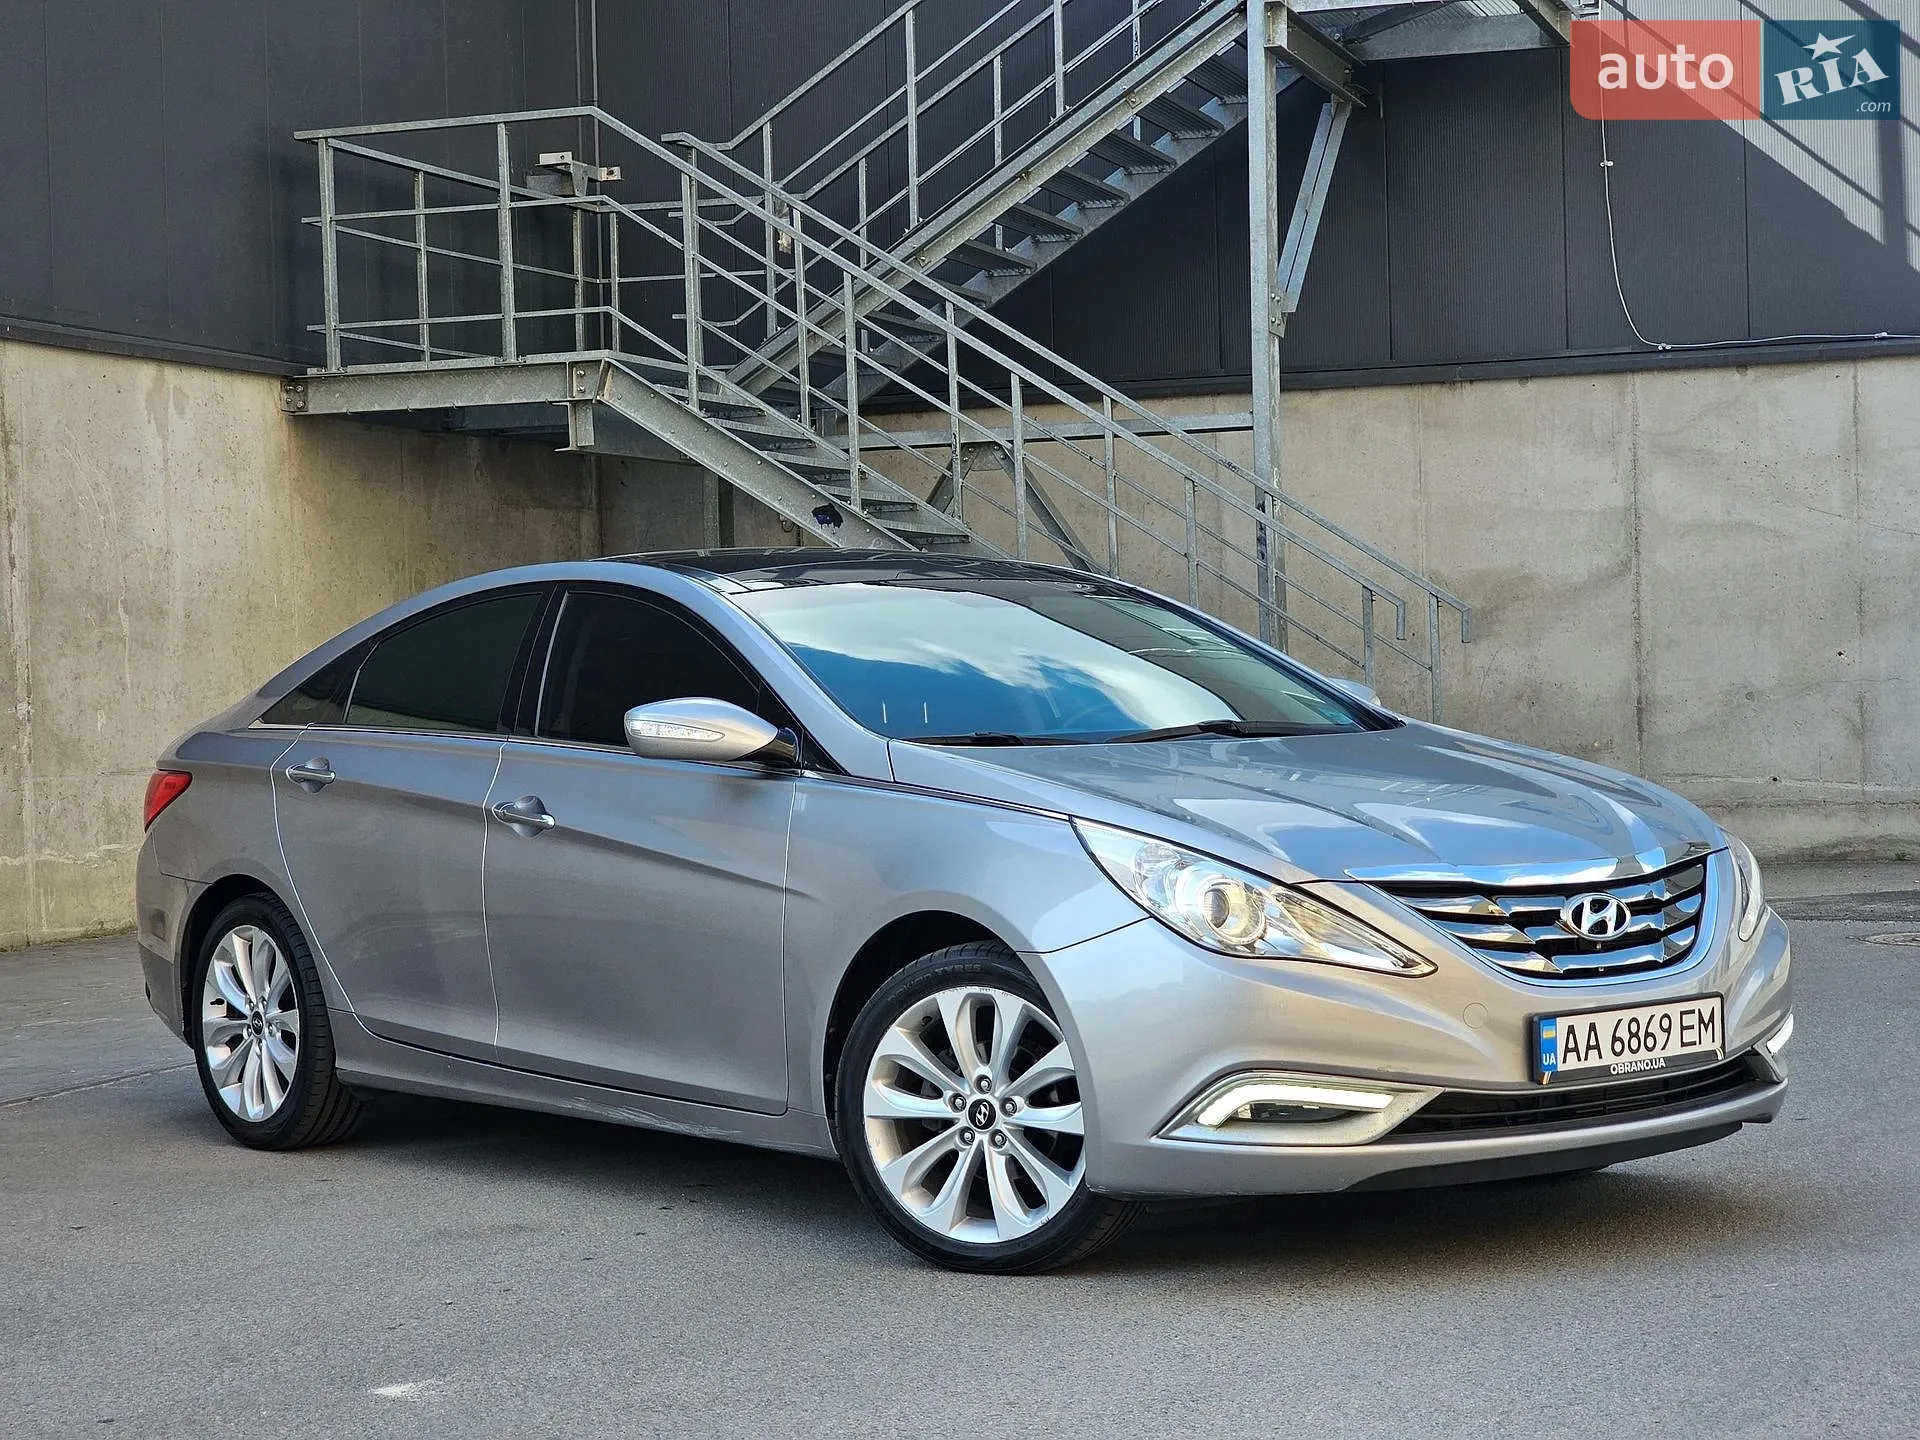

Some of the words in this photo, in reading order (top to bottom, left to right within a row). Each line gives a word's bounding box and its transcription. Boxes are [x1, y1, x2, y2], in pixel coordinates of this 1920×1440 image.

[934, 963, 982, 977] TYRES
[1562, 1022, 1603, 1064] AA
[1610, 1012, 1673, 1058] 6869
[1679, 1006, 1716, 1048] EM
[1542, 1053, 1557, 1066] UA
[1610, 1057, 1666, 1075] OBRANO.UA
